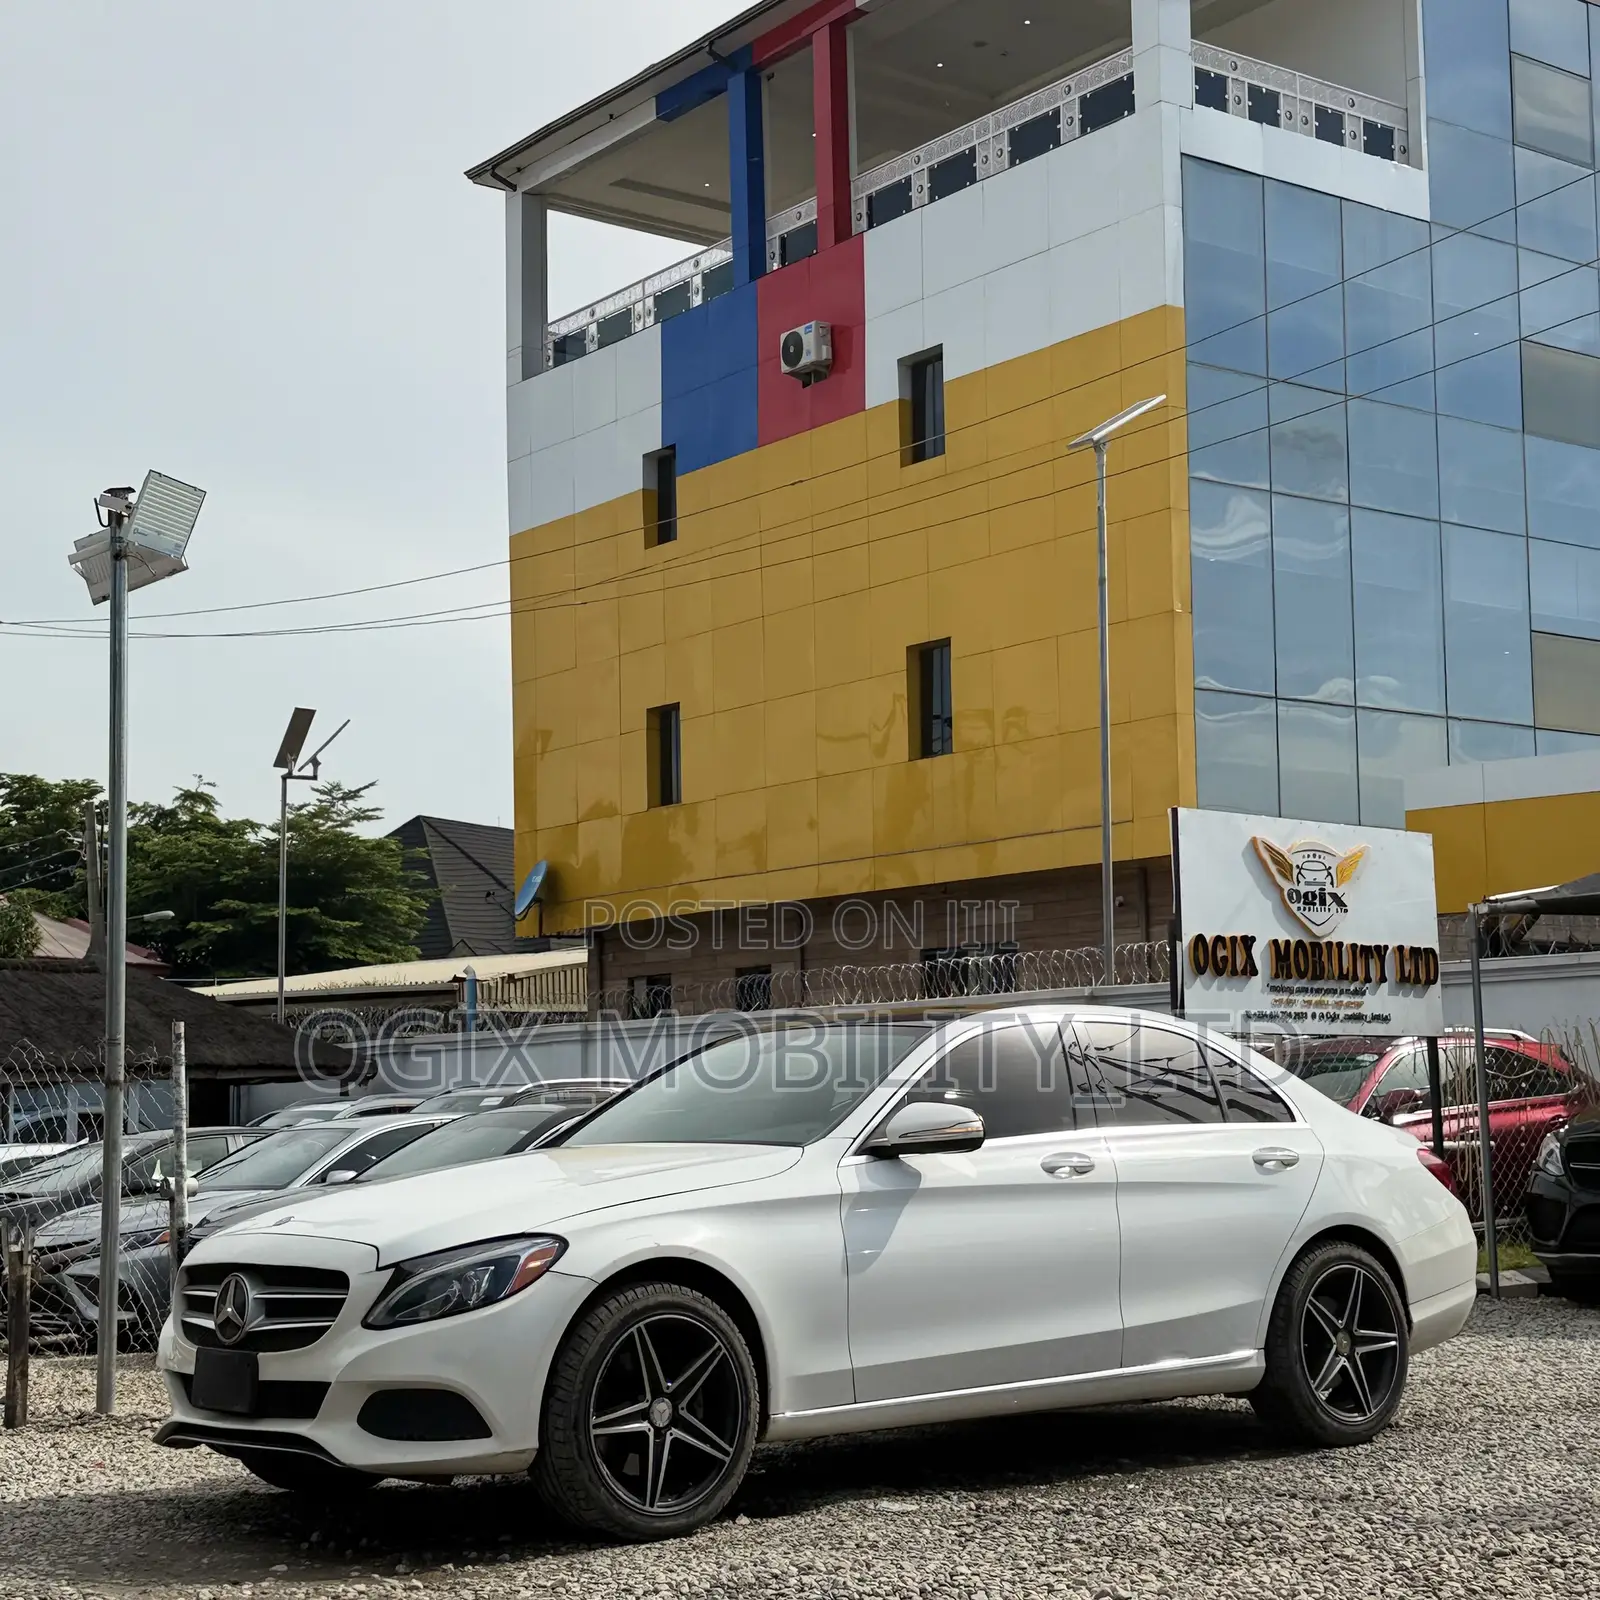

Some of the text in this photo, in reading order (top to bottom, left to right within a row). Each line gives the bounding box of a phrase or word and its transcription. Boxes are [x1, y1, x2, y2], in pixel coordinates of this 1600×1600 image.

[1189, 933, 1439, 985] OGIX MOBILITY LTD
